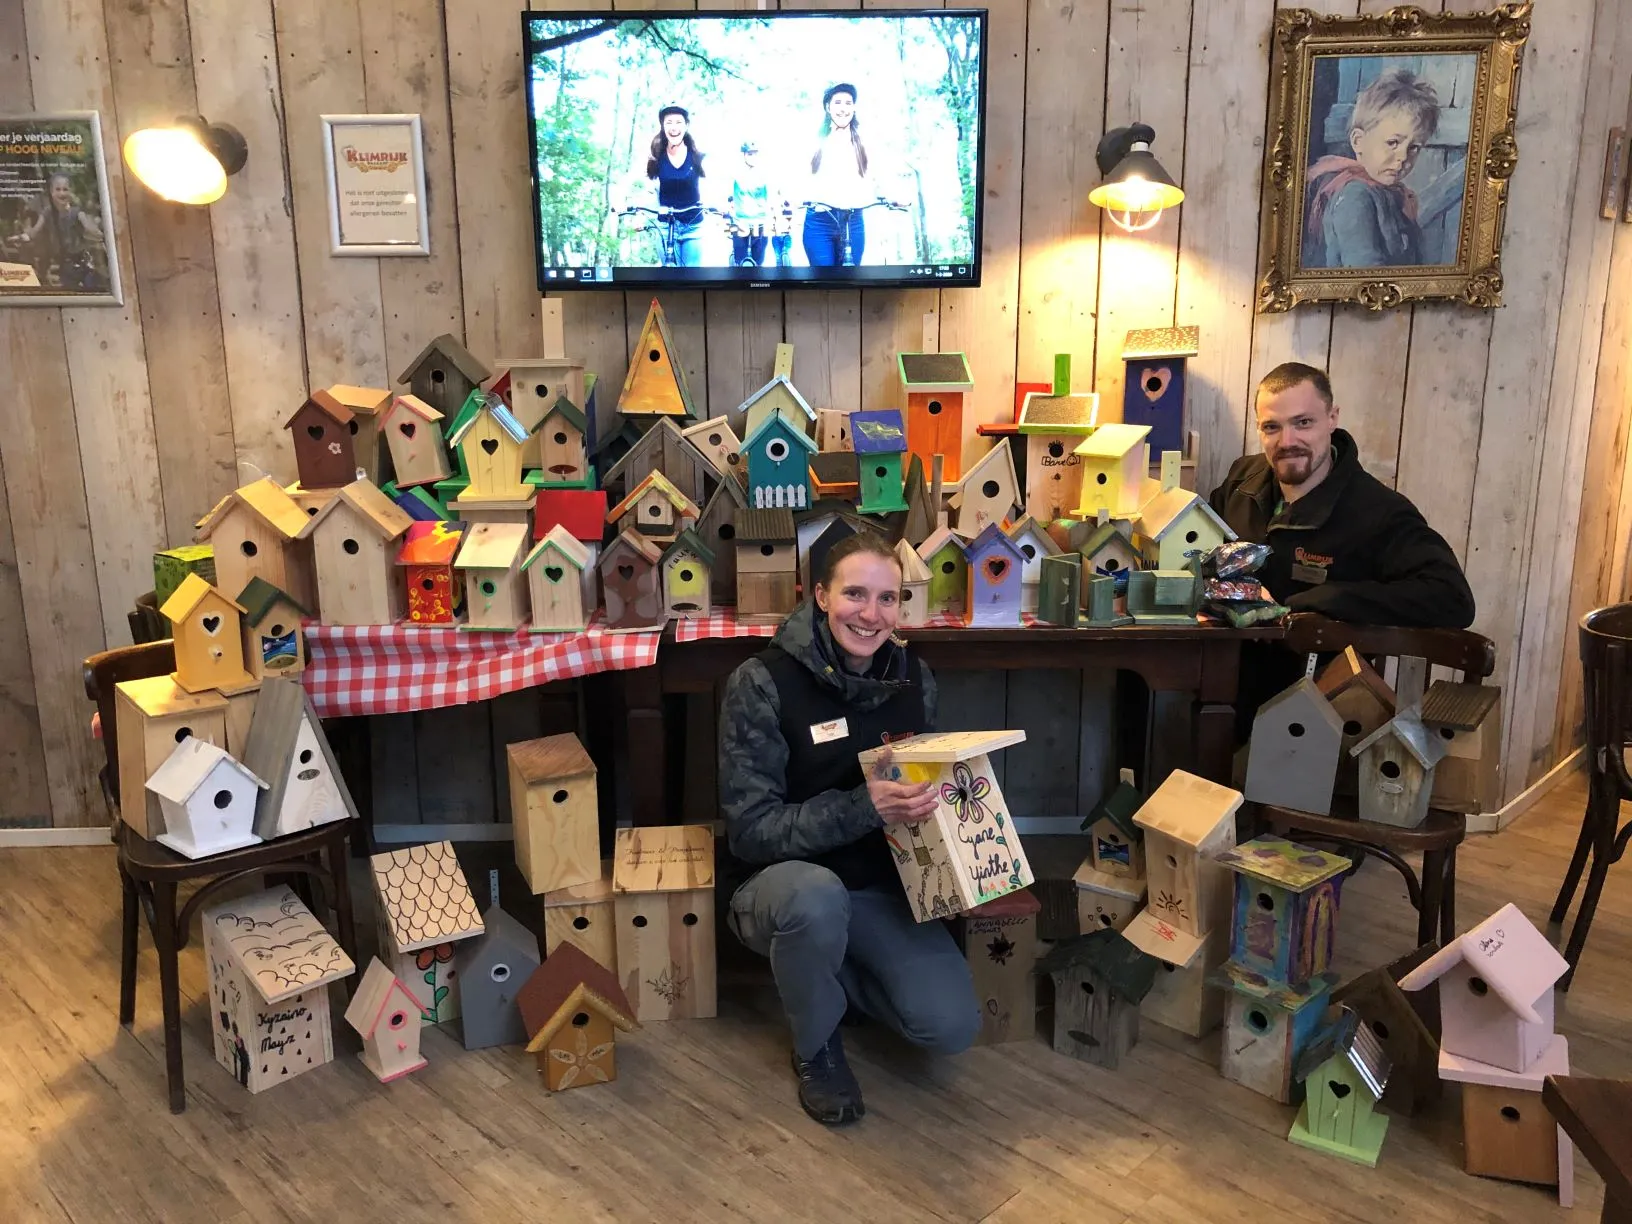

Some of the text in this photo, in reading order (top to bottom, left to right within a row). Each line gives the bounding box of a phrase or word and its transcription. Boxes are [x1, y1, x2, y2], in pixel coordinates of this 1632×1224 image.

[12, 131, 23, 143] je
[24, 131, 83, 144] verjaardag
[7, 145, 39, 154] HOOG
[346, 150, 408, 162] KLIMRIJK
